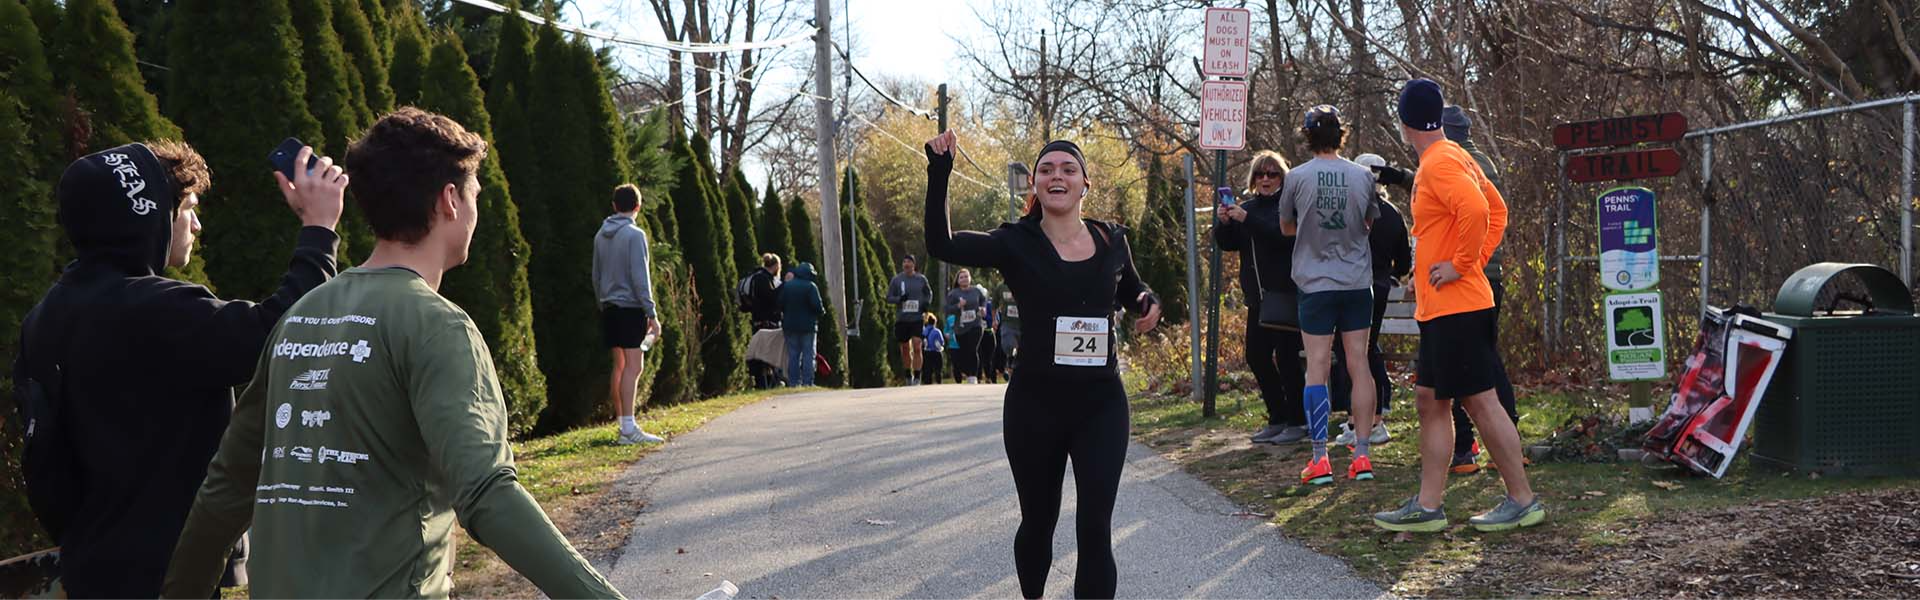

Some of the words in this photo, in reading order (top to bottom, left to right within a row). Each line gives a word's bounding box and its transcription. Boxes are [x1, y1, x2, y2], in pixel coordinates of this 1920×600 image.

[1220, 13, 1235, 23] ALL
[1216, 26, 1238, 35] DOGS
[1209, 37, 1231, 46] MUST
[1234, 38, 1245, 47] BE
[1220, 49, 1231, 58] ON
[1211, 61, 1239, 70] LEASH
[1205, 88, 1243, 101] AUTHORIZED
[1204, 108, 1243, 122] VEHICLES
[1571, 114, 1664, 144] PENNSY
[1211, 129, 1232, 141] ONLY
[1584, 152, 1661, 177] TRAIL
[1317, 171, 1348, 187] ROLL
[1317, 188, 1333, 196] WITH
[1335, 188, 1348, 197] THE
[1316, 197, 1347, 209] CREW
[1604, 195, 1640, 204] PENNSY
[1605, 203, 1632, 213] TRAIL
[304, 317, 320, 325] YOU
[1072, 336, 1097, 353] 24
